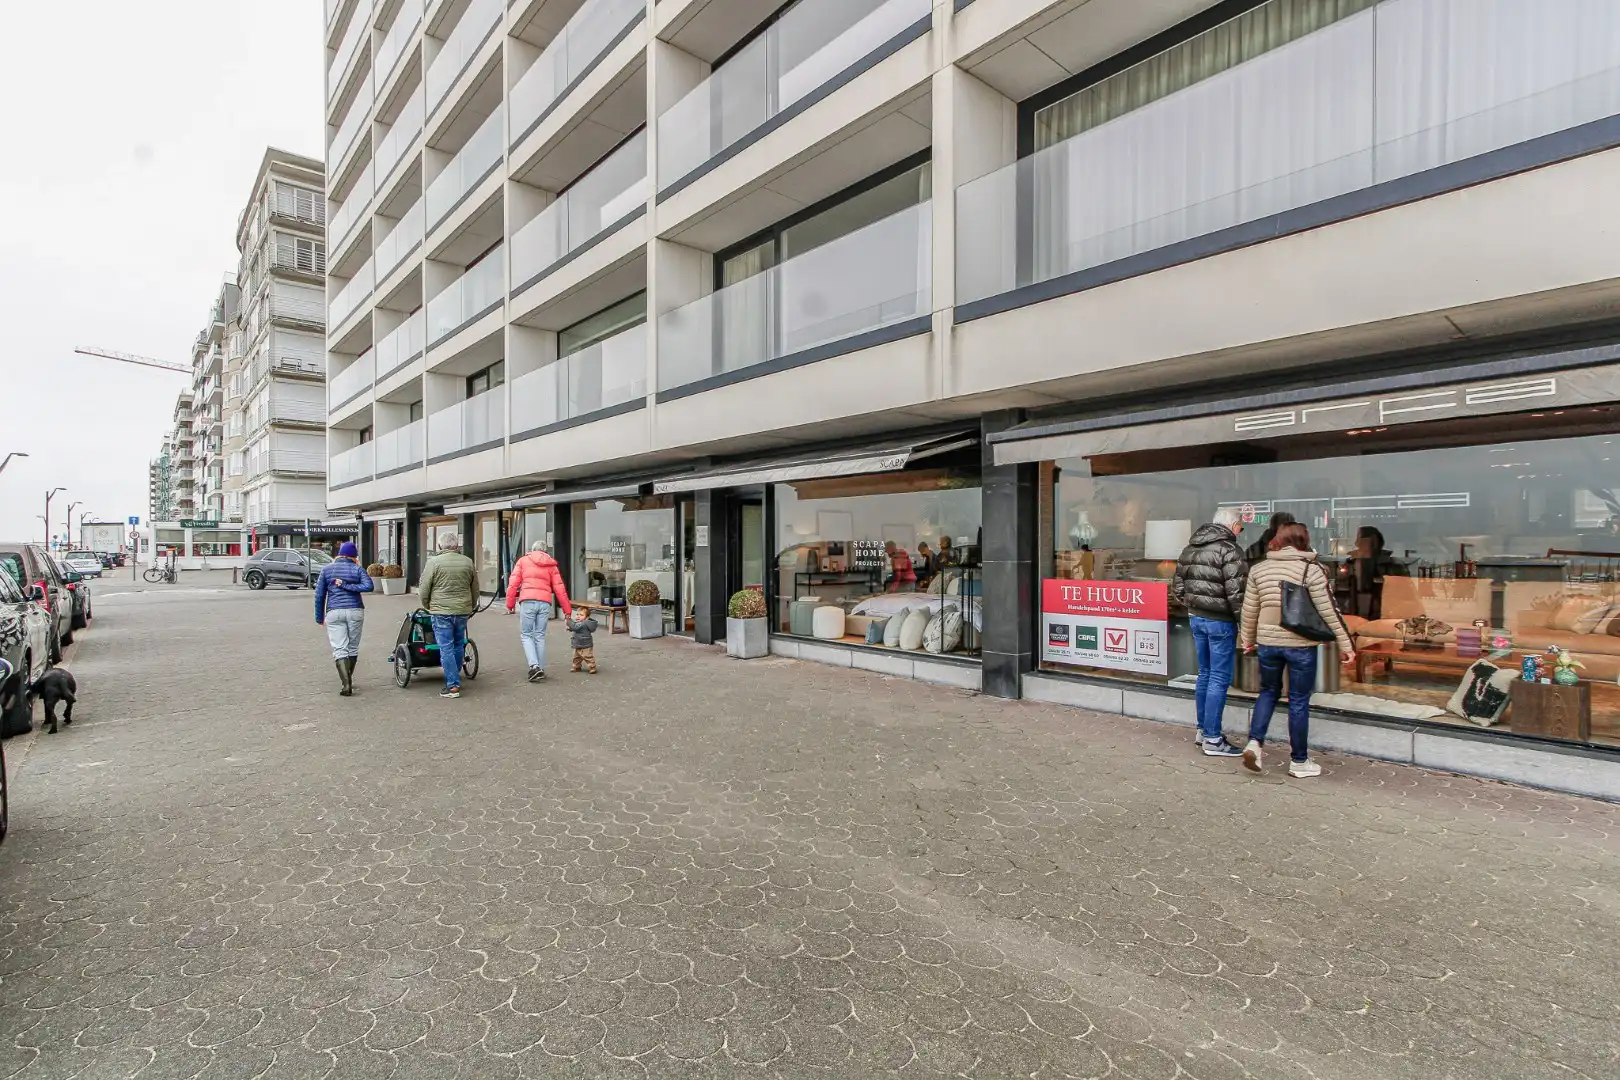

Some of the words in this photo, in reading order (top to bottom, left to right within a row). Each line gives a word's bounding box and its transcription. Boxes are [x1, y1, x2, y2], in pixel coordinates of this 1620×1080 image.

[852, 540, 886, 548] SCAPA
[855, 549, 885, 557] HOME
[1060, 585, 1082, 601] TE
[1087, 586, 1145, 605] HUUR
[1077, 634, 1096, 642] CBRE
